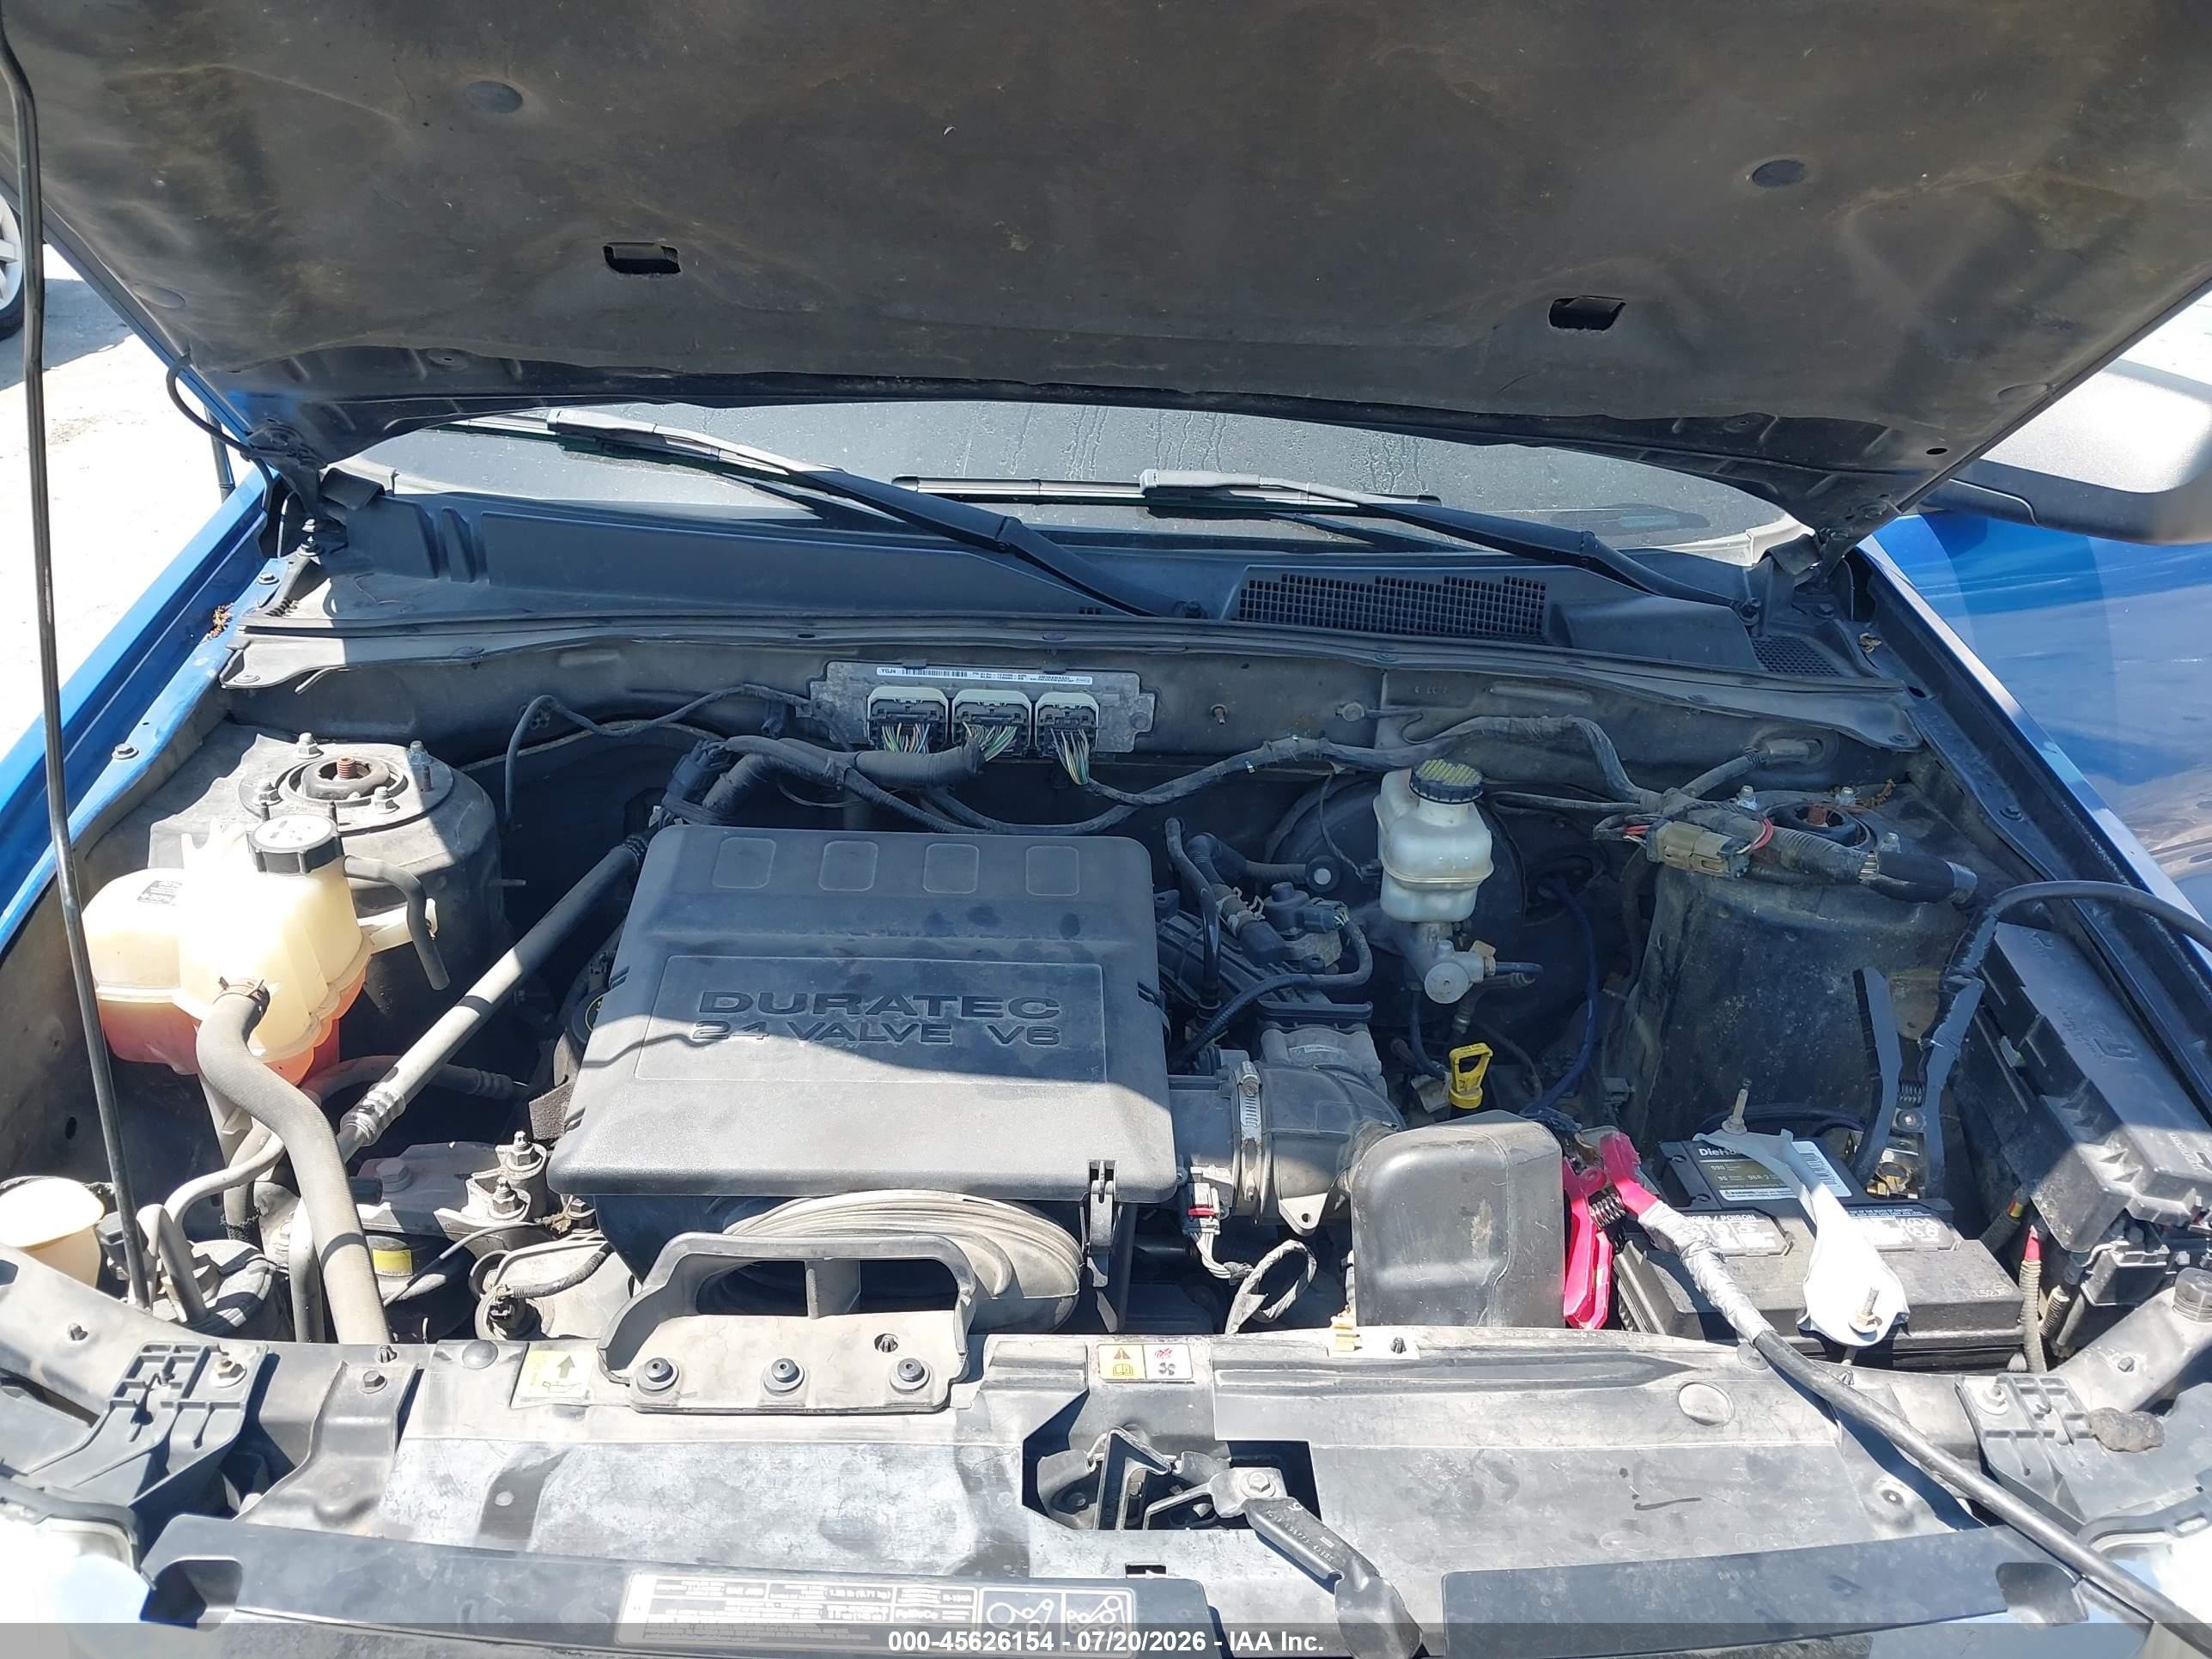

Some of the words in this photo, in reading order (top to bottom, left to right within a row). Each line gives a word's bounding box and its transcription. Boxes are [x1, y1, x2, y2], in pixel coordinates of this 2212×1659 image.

[698, 991, 1060, 1020] DURATEC
[692, 1020, 769, 1041] 24
[787, 1021, 951, 1045] VALVE
[988, 1024, 1060, 1047] V6
